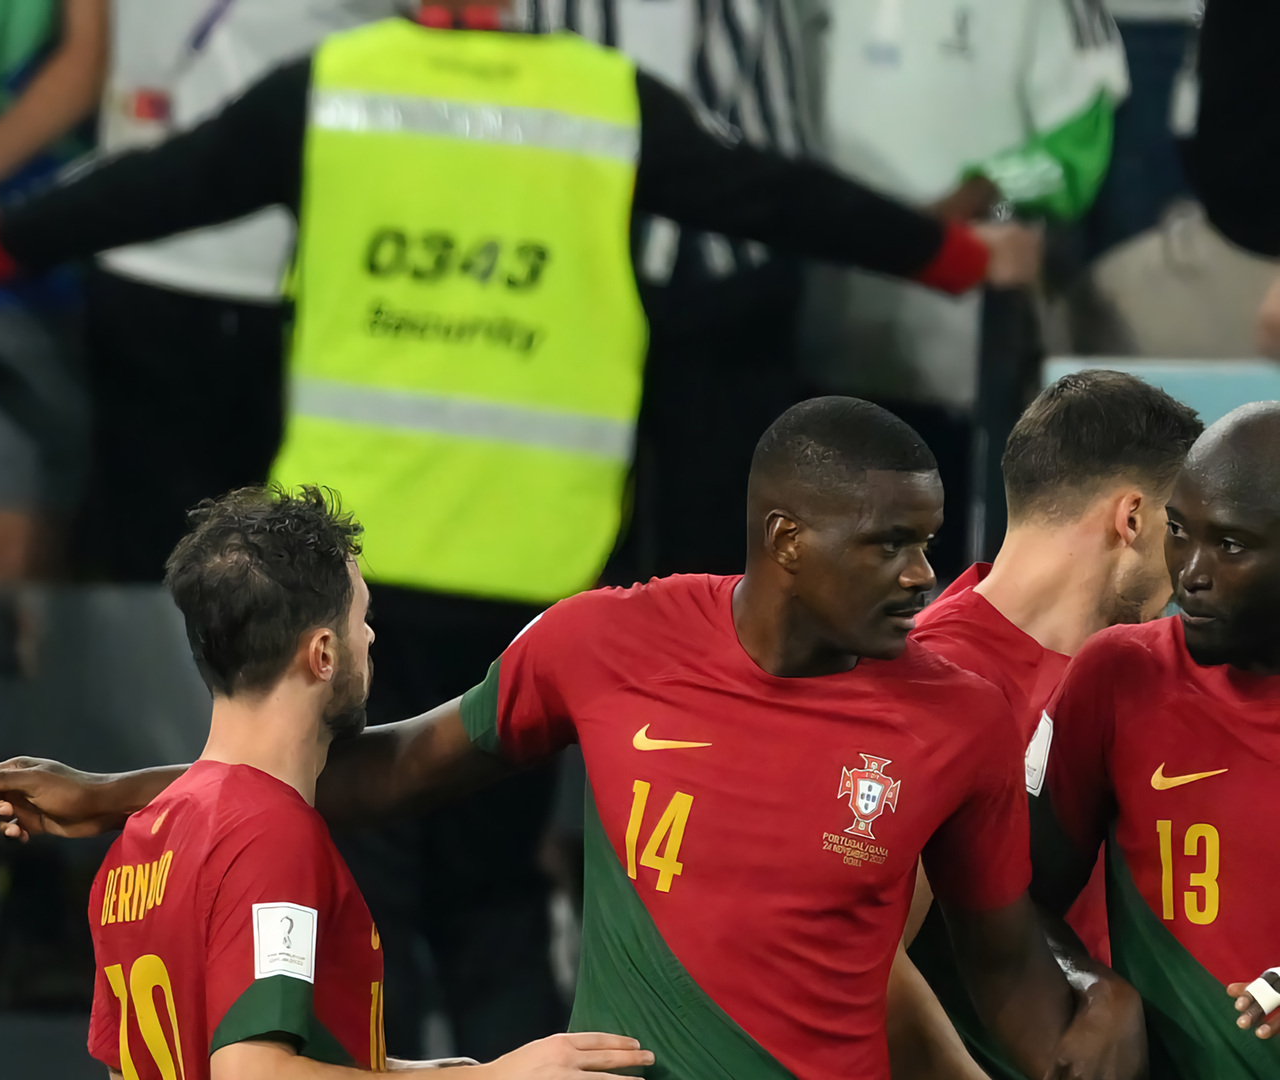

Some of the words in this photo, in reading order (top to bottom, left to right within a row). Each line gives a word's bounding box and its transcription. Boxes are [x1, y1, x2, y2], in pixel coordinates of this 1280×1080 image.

[364, 226, 552, 291] 0343
[363, 300, 543, 357] Security
[625, 779, 694, 893] 14
[1155, 819, 1220, 925] 13
